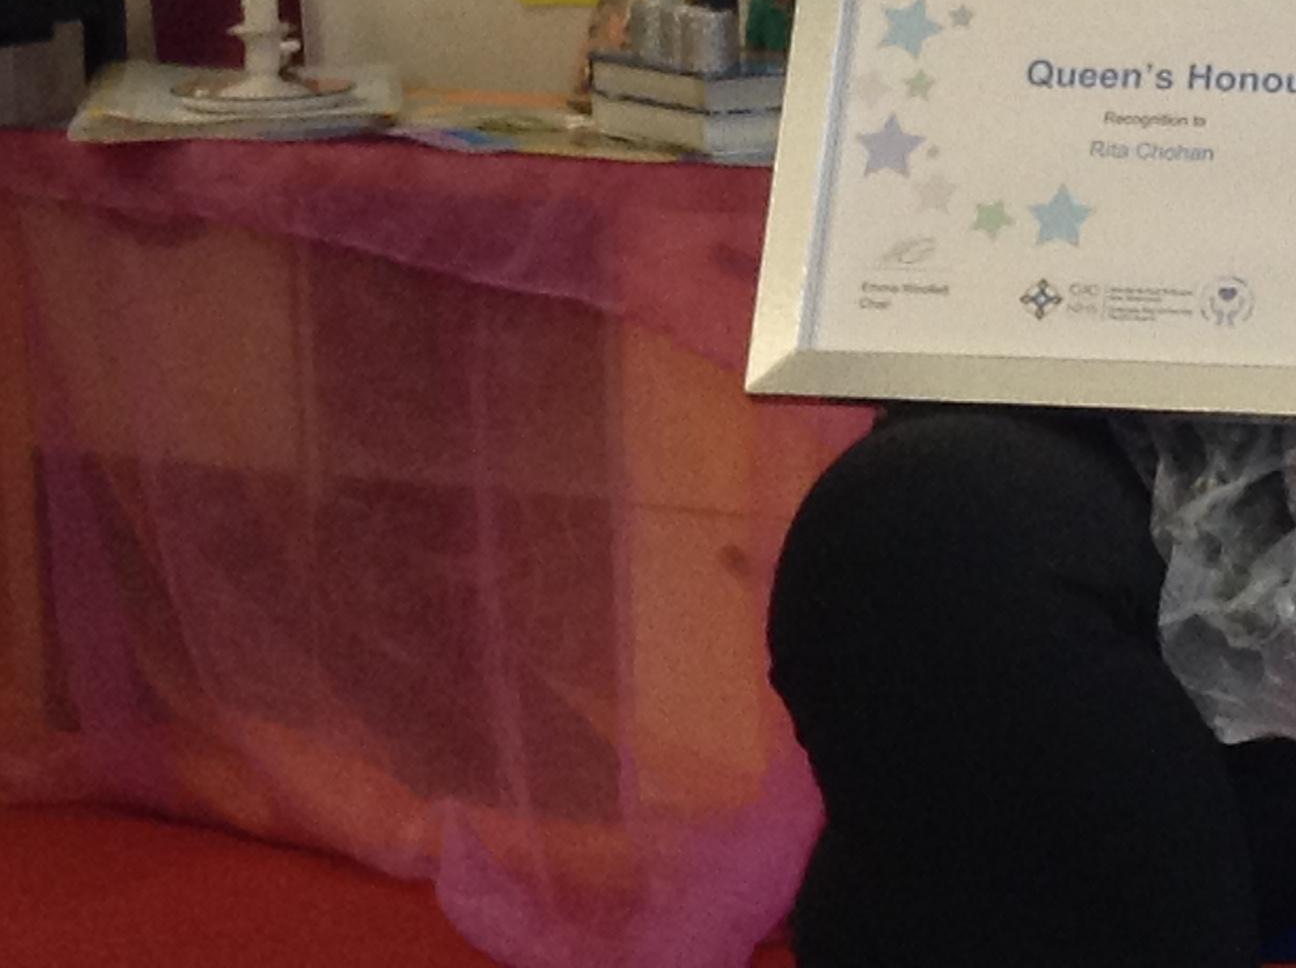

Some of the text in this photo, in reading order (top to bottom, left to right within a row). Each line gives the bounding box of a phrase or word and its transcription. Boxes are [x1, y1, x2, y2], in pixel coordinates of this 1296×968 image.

[1025, 58, 1174, 90] Queen's
[1103, 110, 1207, 129] Recognition to
[1089, 139, 1130, 159] Rita
